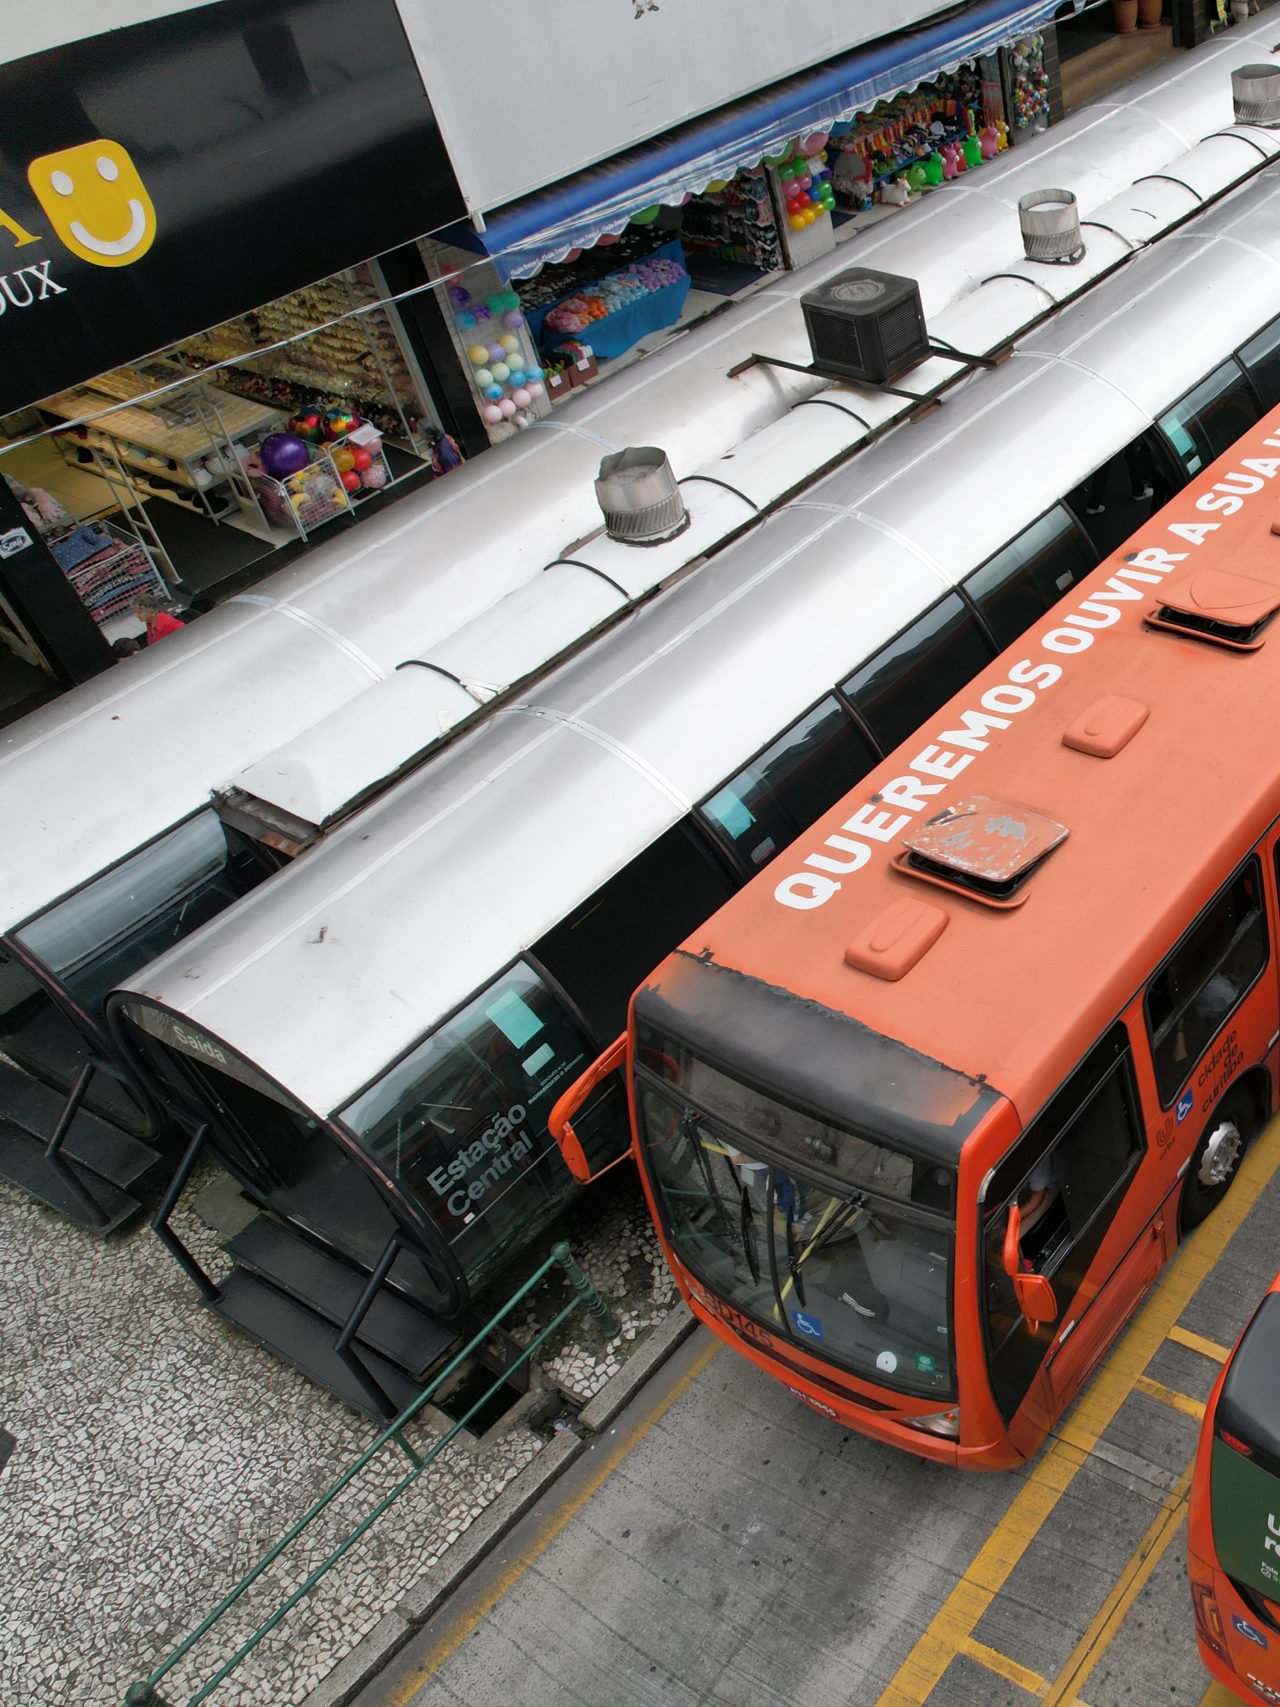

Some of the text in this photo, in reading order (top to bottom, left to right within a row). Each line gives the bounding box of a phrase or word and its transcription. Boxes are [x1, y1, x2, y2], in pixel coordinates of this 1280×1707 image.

[774, 659, 1063, 910] QUEREMOS
[1042, 548, 1190, 654] OUVIR
[1168, 522, 1222, 546] A
[173, 1025, 227, 1064] Saída
[1198, 1029, 1237, 1087] cidade
[1224, 1044, 1238, 1069] de
[1202, 1050, 1244, 1112] curitiba
[426, 1104, 526, 1196] Estação
[447, 1130, 533, 1217] Central
[1261, 1561, 1279, 1576] Fale
